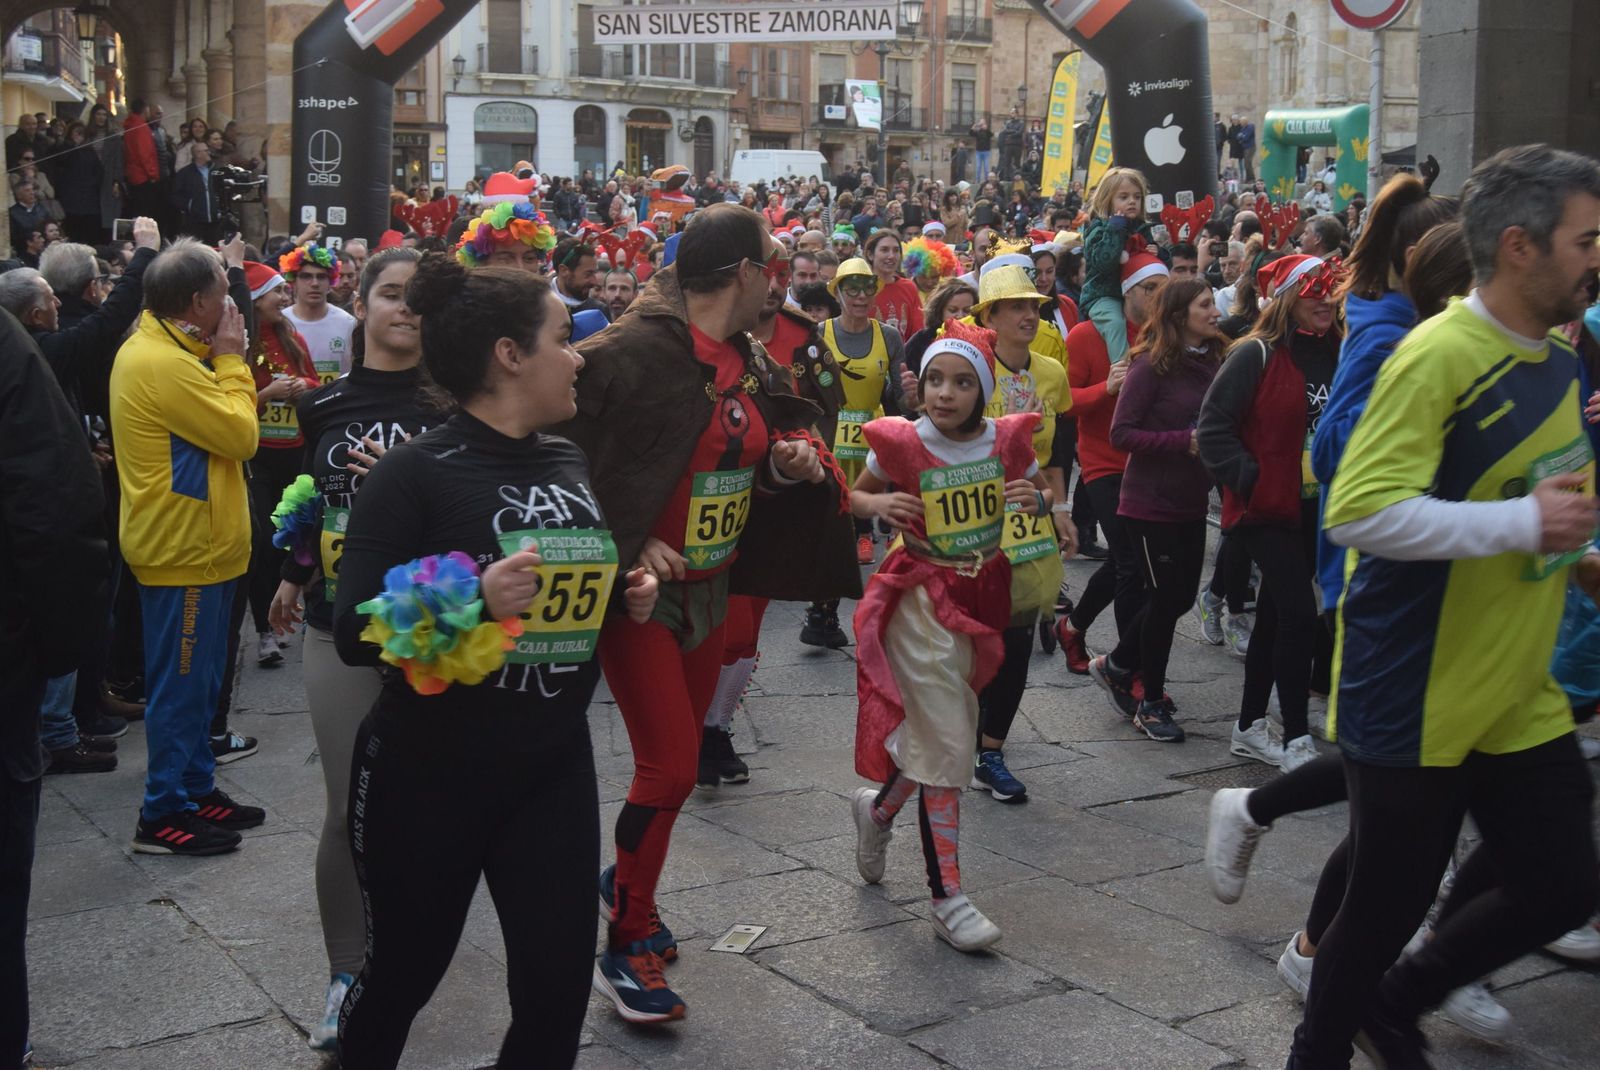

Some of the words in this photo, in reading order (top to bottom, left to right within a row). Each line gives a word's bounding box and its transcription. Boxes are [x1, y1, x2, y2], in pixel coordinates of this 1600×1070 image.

[597, 13, 642, 36] SAN
[649, 11, 761, 35] SILVESTRE
[768, 8, 893, 34] ZAMORANA
[1144, 77, 1190, 91] invisalign
[298, 96, 347, 110] 3shape
[1286, 119, 1304, 134] CAJA
[1305, 118, 1332, 134] RURAL
[307, 172, 341, 184] DSD
[944, 341, 979, 359] LEGION
[949, 475, 970, 486] CAJA
[972, 469, 998, 482] RURAL
[325, 482, 345, 491] 2022
[492, 482, 601, 534] SAN
[936, 483, 998, 526] 1016
[697, 495, 748, 541] 562
[956, 533, 980, 547] CAJA
[477, 552, 494, 564] 31
[543, 549, 570, 562] CAJA
[571, 548, 606, 562] RURAL
[182, 586, 202, 635] Atletismo
[516, 641, 549, 654] CAJA
[551, 639, 590, 653] RURAL
[179, 636, 198, 675] Zamora
[354, 765, 371, 819] BLACK
[343, 978, 365, 1016] BLACK
